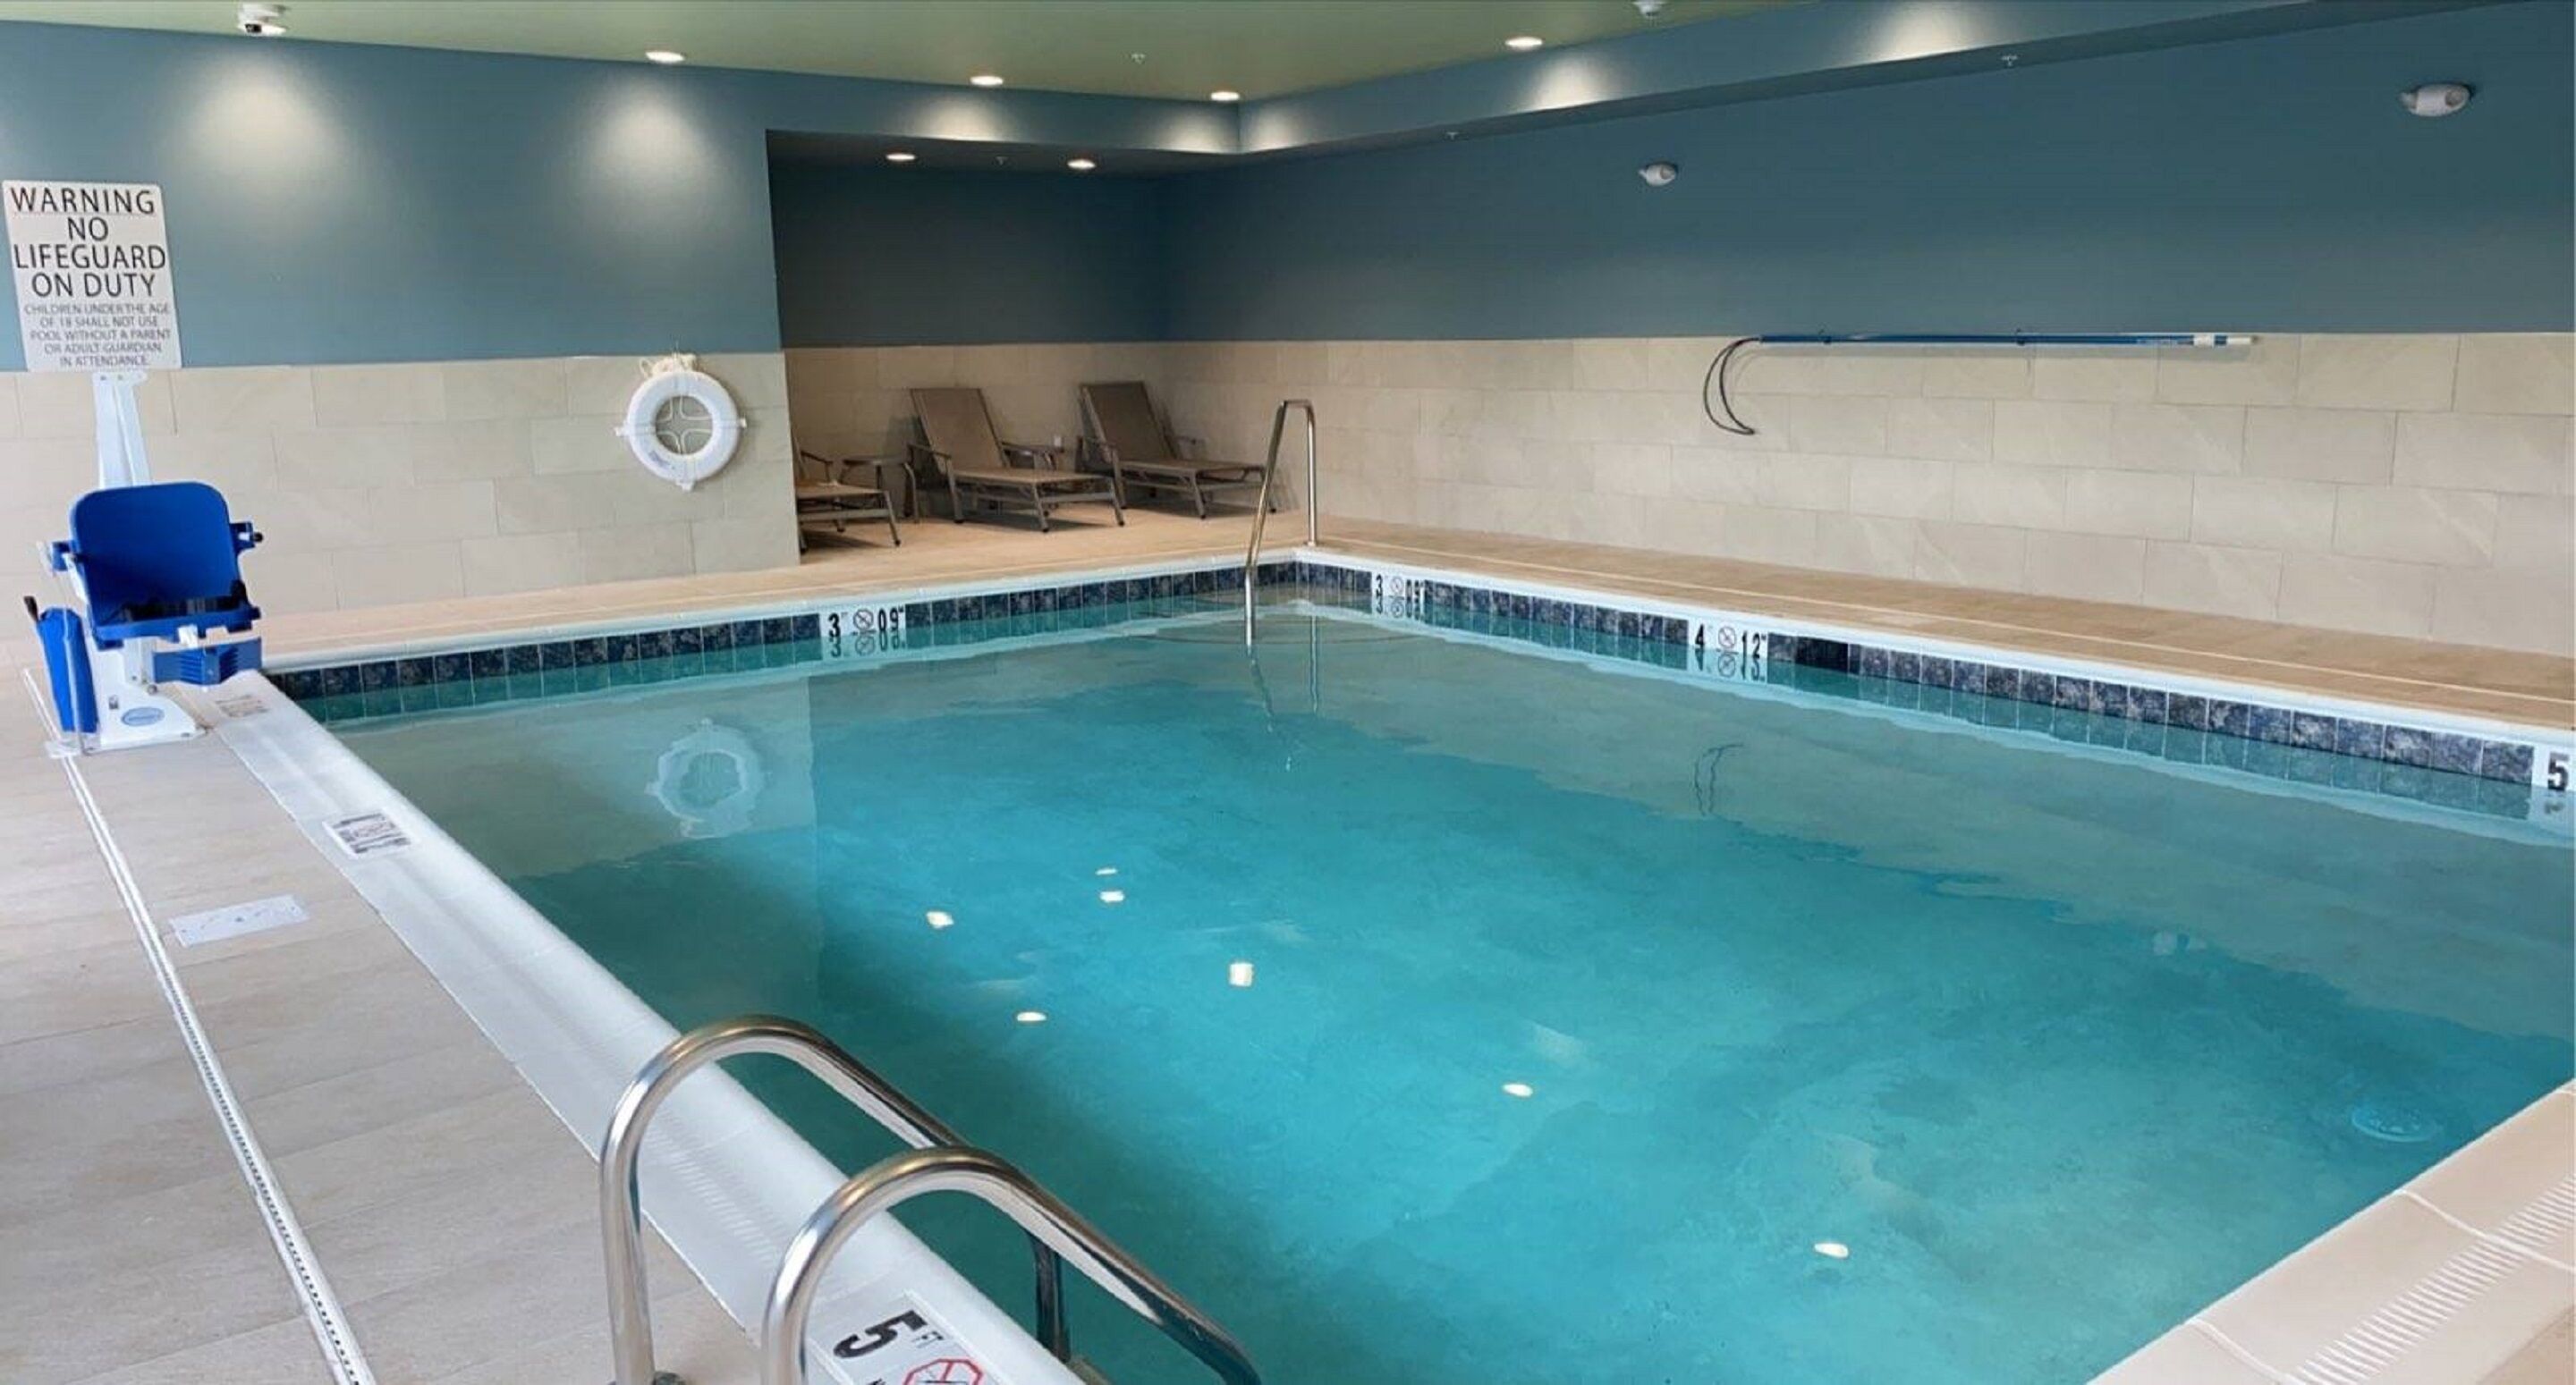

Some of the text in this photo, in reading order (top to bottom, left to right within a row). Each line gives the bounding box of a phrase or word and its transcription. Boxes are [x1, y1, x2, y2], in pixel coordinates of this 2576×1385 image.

[11, 187, 155, 215] WARNING
[67, 216, 109, 241] NO
[14, 244, 166, 269] LIFEGUARD
[31, 272, 156, 298] ON DUTY
[124, 303, 145, 314] THE
[39, 316, 54, 327] OF
[75, 316, 110, 327] SHALL
[113, 316, 134, 327] NOT
[138, 316, 157, 327] USE
[64, 329, 117, 341] WITHOUT
[120, 329, 129, 340] A
[131, 328, 171, 340] PARENT
[64, 342, 99, 353] ADULT
[59, 356, 72, 367] IN
[828, 612, 841, 638] 3
[1695, 624, 1705, 649] 4
[2547, 752, 2569, 792] 5
[834, 1310, 928, 1358] 5
